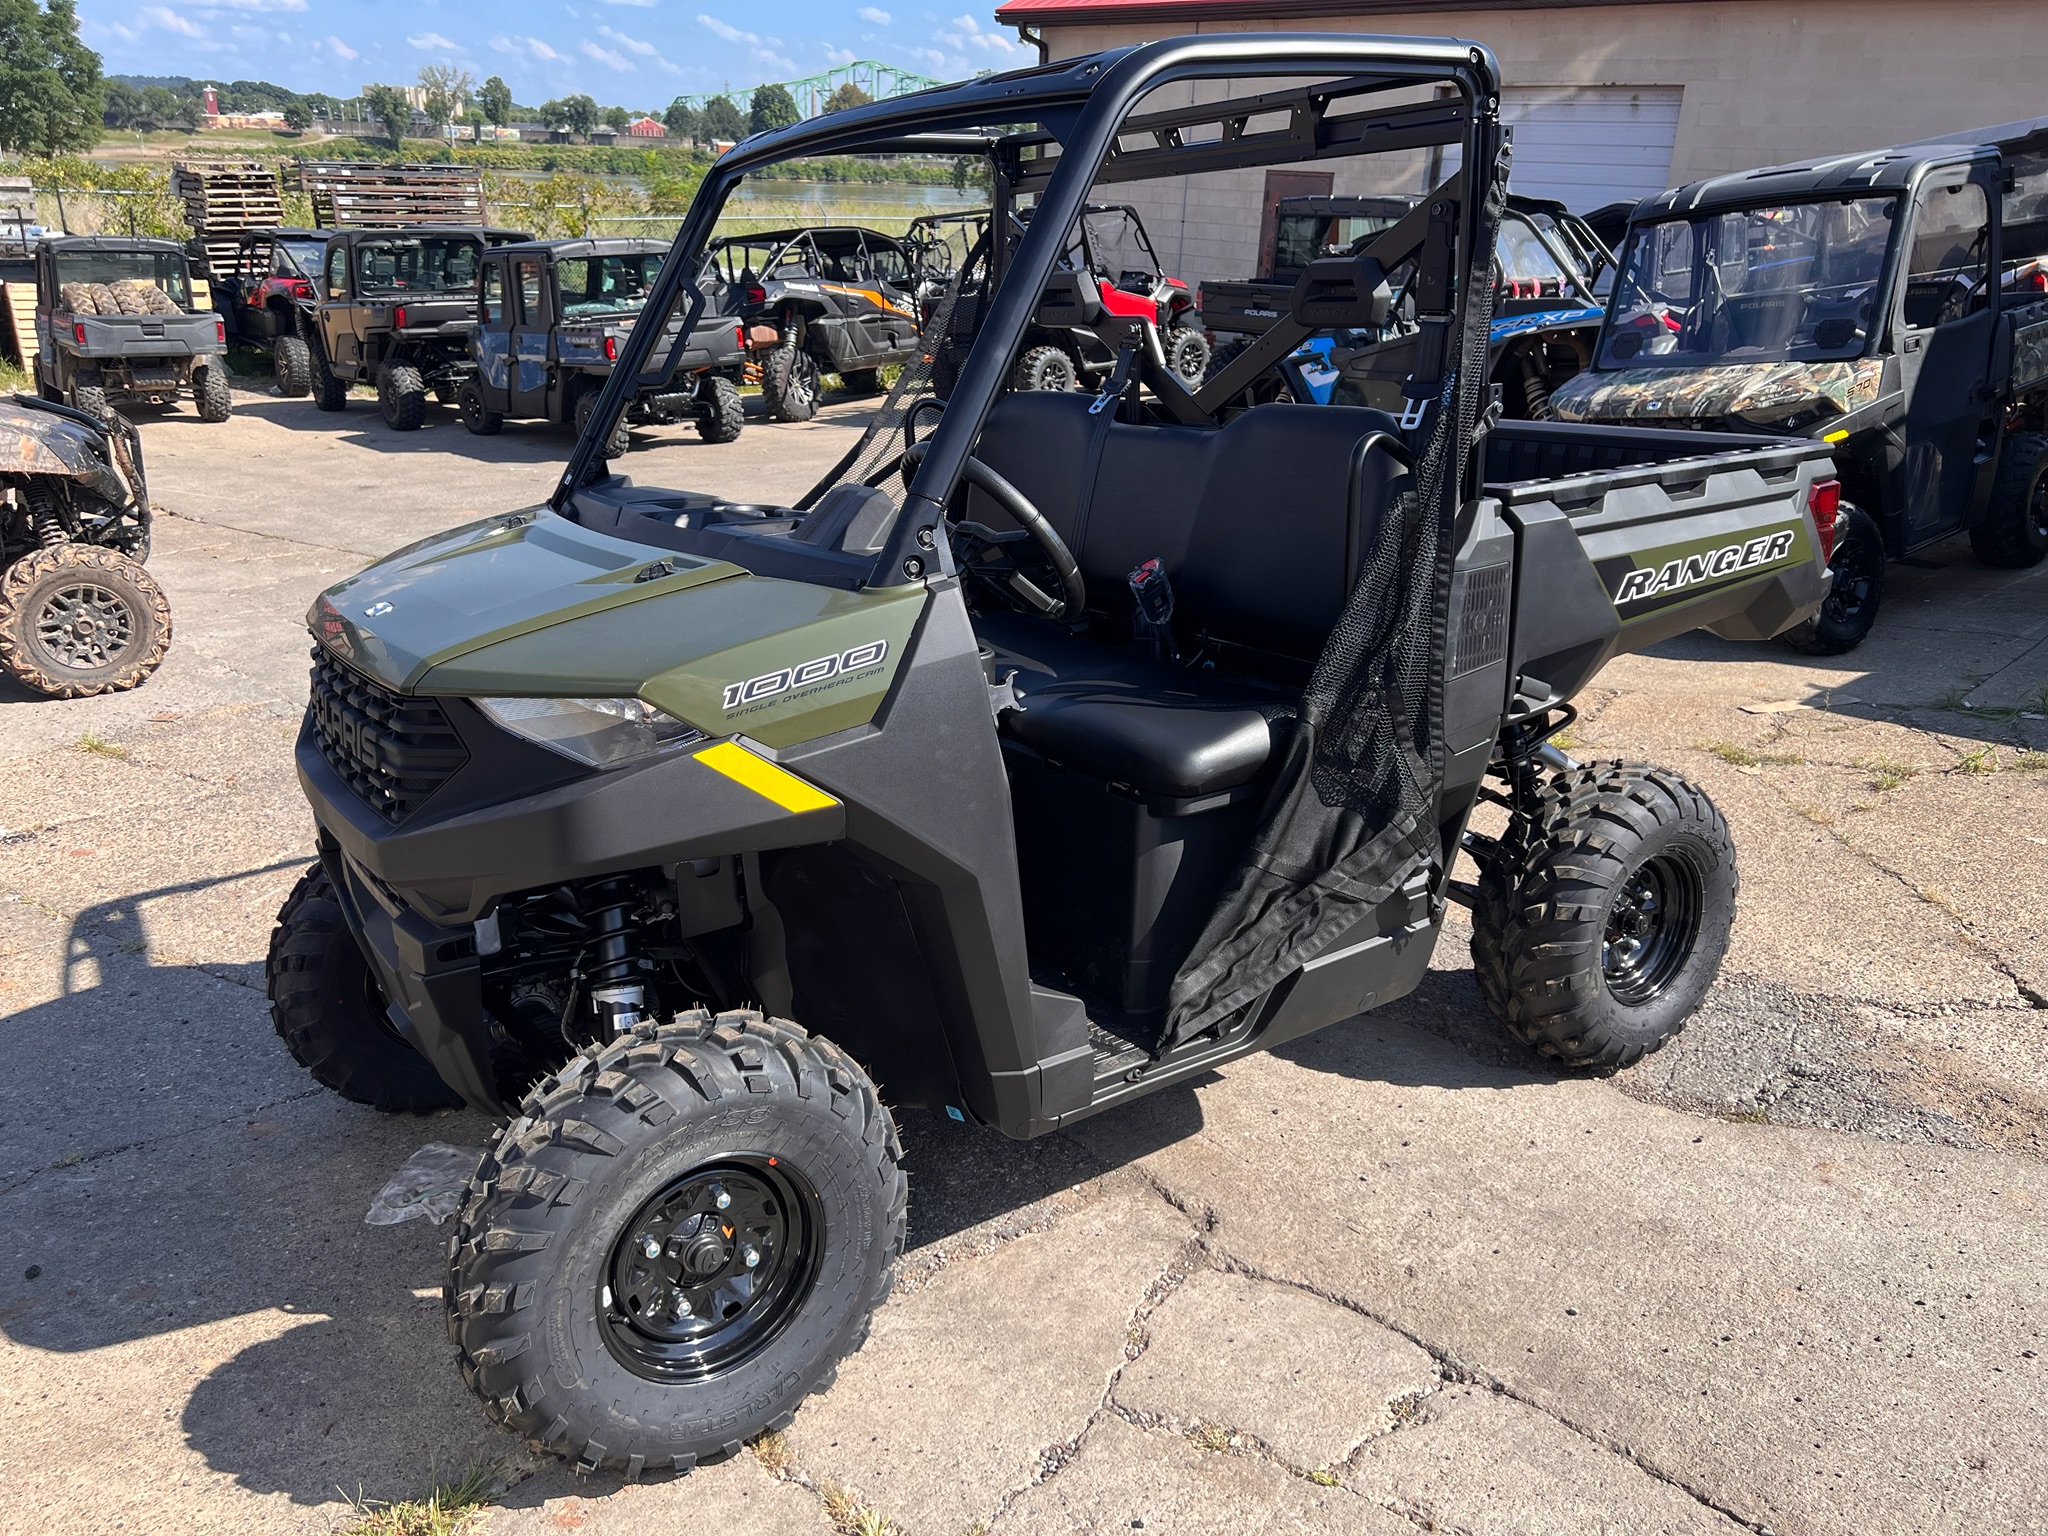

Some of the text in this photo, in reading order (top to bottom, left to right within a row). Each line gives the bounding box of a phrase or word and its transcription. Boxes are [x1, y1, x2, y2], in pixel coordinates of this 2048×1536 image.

[1907, 287, 1939, 296] ARIS
[1244, 308, 1278, 318] POLARIS
[1741, 300, 1786, 310] POLARIS
[564, 336, 597, 345] RANGER
[1846, 378, 1872, 398] 570
[1614, 530, 1795, 605] RANGER
[722, 639, 890, 710] 1000
[725, 667, 885, 720] SINGLE OVERHEAD CAM
[669, 1369, 801, 1441] CARLSTAR
